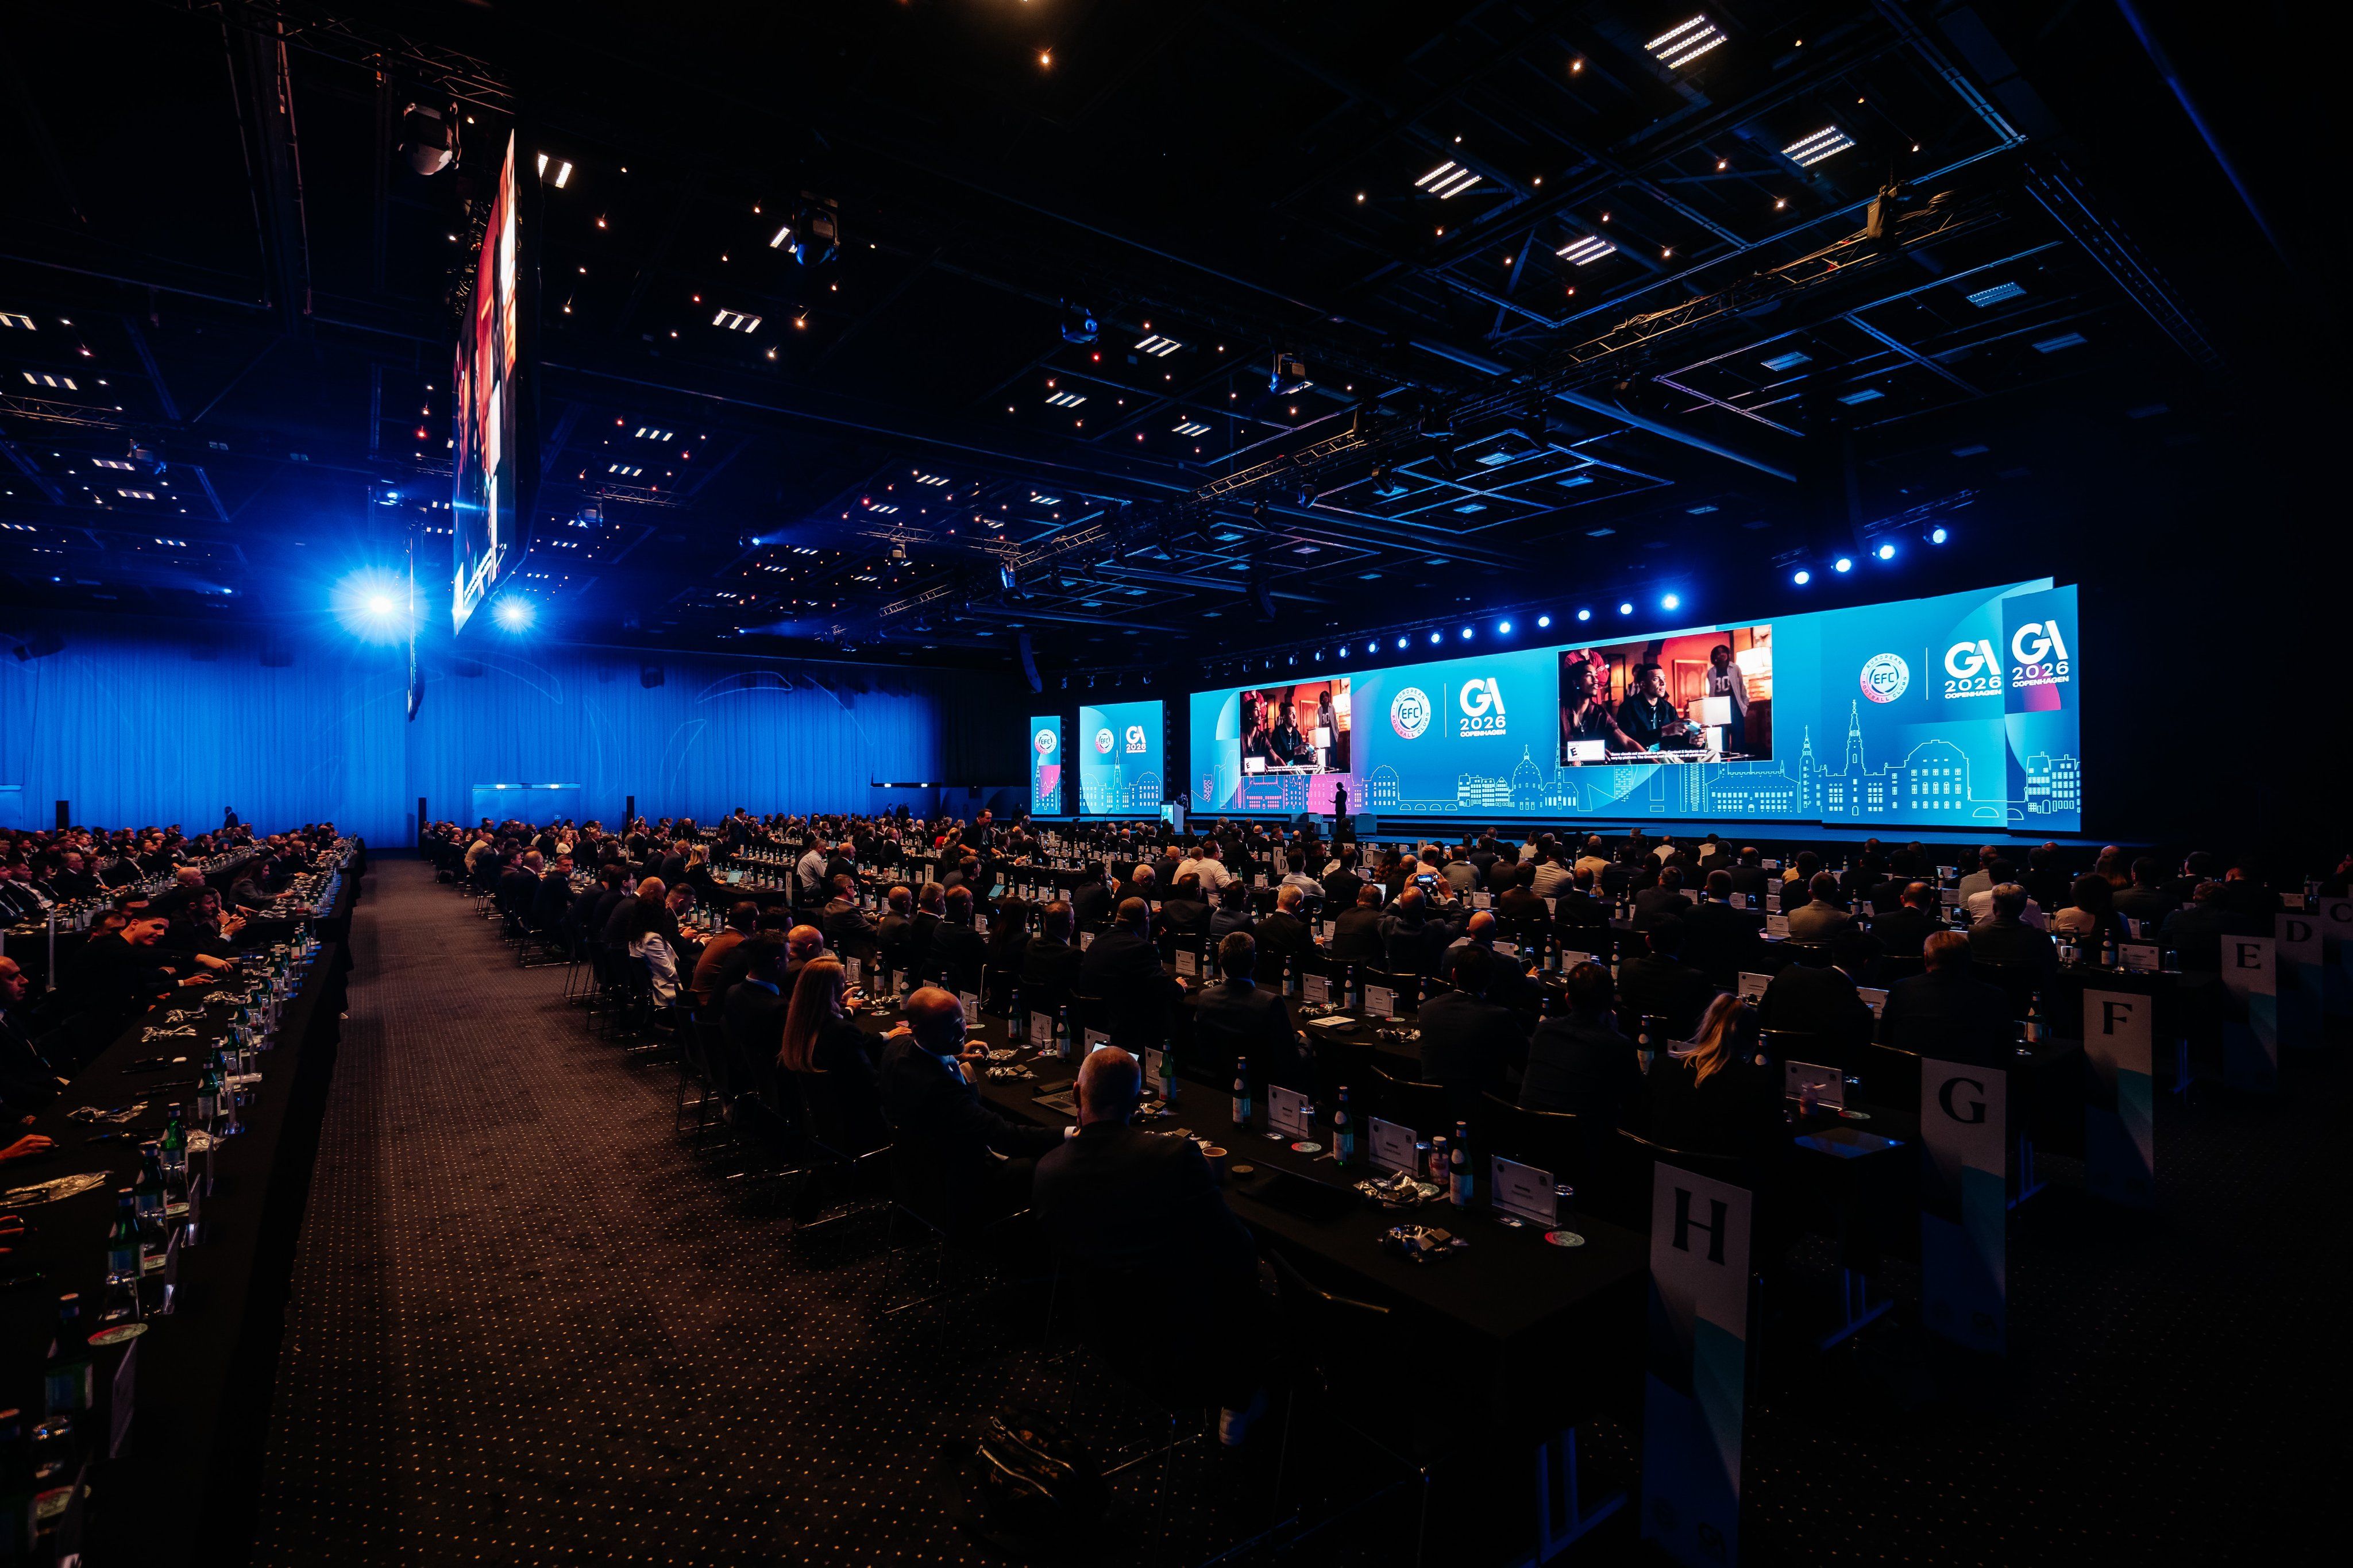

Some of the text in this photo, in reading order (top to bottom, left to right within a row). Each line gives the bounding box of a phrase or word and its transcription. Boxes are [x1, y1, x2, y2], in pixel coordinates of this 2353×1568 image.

[2012, 620, 2069, 665] GA
[1866, 655, 1902, 668] EUROPEAN
[1945, 639, 2001, 679] GA
[1874, 672, 1895, 684] EFC
[2012, 663, 2069, 680] 2026
[1862, 677, 1907, 701] FOOTBALL CLUBS
[1945, 676, 2001, 693] 2026
[2012, 675, 2069, 688] COPENHAGEN
[1395, 689, 1425, 702] EUROPEAN
[1460, 678, 1506, 717] GA
[1945, 689, 2001, 699] COPENHAGEN
[1402, 707, 1419, 719] EFC
[1392, 712, 1429, 737] FOOTBALL CLUBS
[1460, 715, 1506, 731] 2026
[1460, 729, 1506, 737] COPENHAGEN
[1570, 747, 1577, 756] E
[1105, 859, 1109, 868] E
[1280, 859, 1286, 869] D
[1365, 853, 1371, 864] C
[927, 868, 932, 879] F
[2329, 903, 2352, 922] C
[2287, 920, 2312, 942] D
[2236, 943, 2261, 969] E
[2103, 1001, 2132, 1034] F
[1939, 1077, 1986, 1124] G
[1672, 1187, 1727, 1266] H
